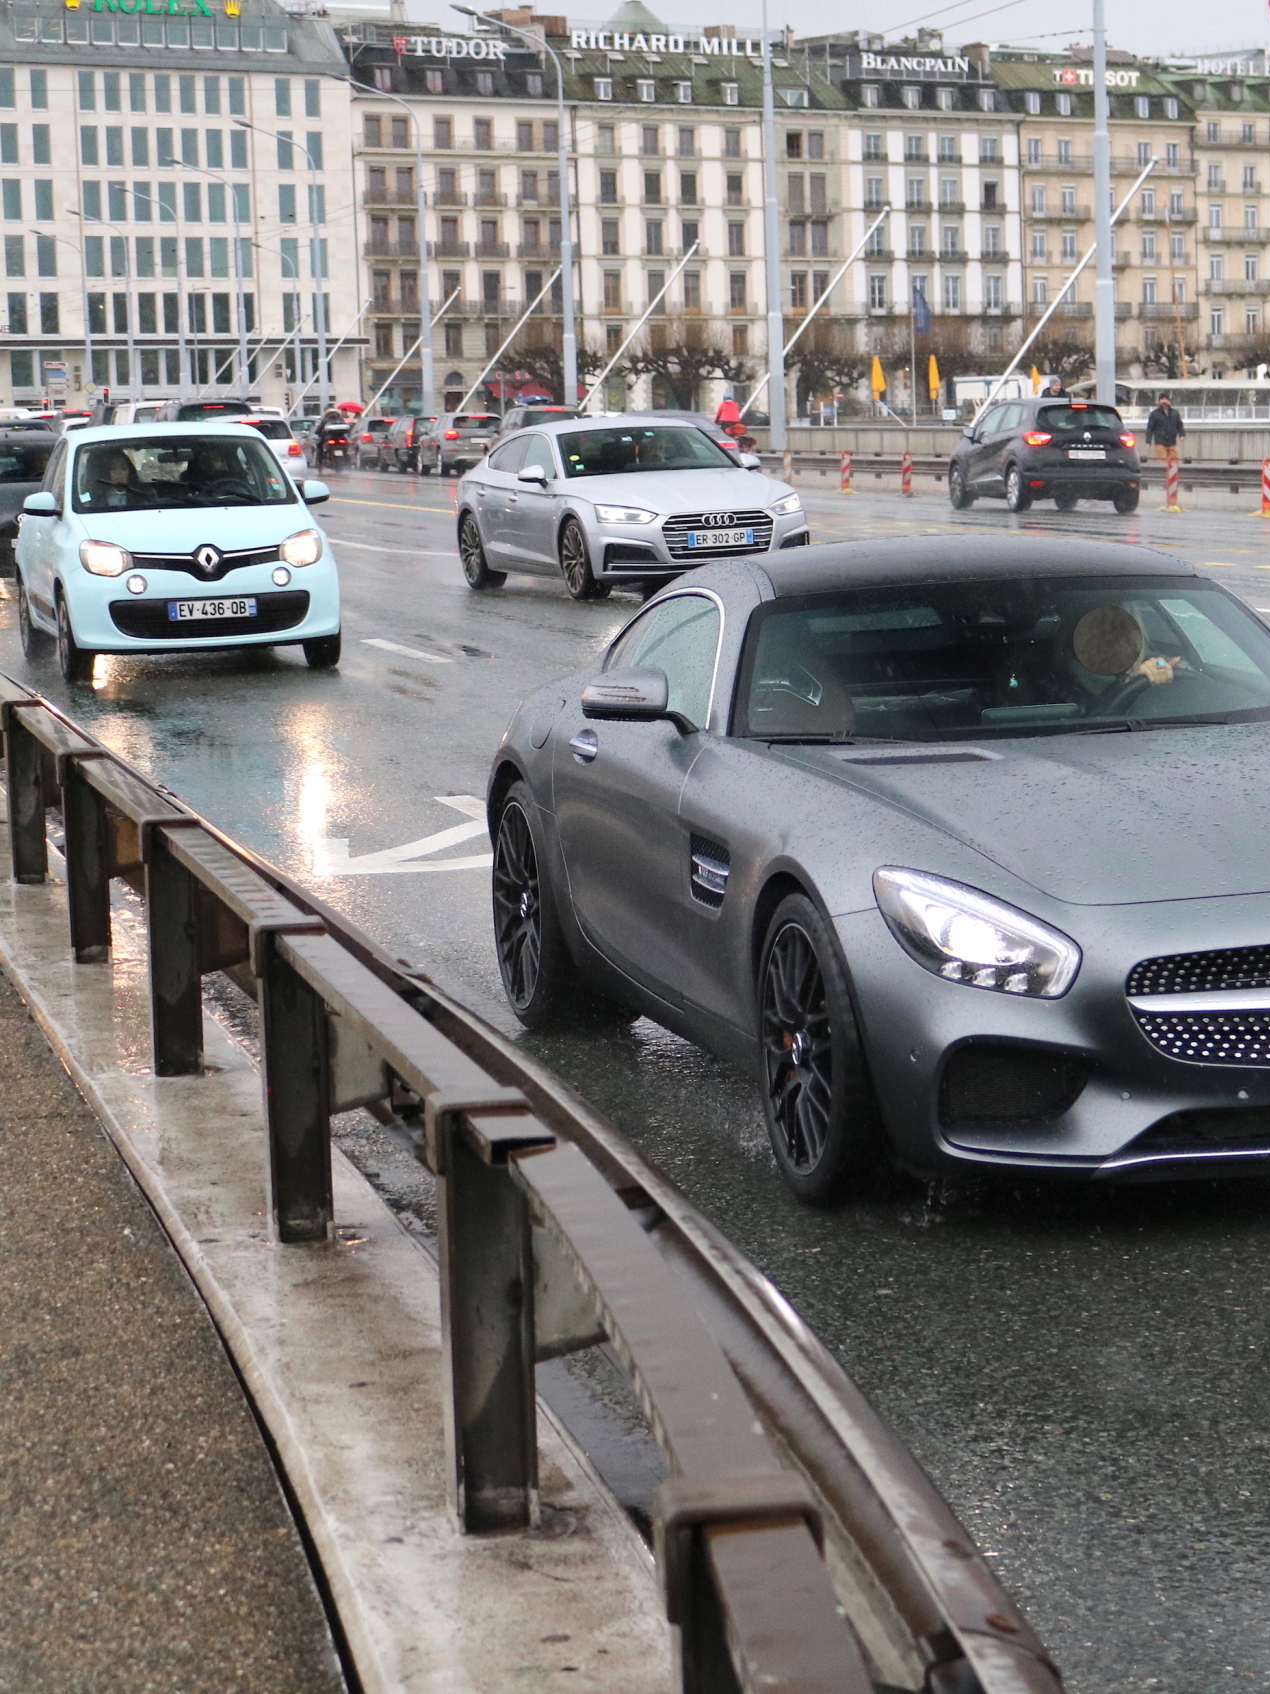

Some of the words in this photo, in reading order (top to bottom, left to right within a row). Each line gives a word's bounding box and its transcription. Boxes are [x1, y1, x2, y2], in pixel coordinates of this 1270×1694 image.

[411, 36, 508, 60] TUDOR
[571, 30, 684, 53] RICHARD
[1076, 69, 1141, 87] TISOT
